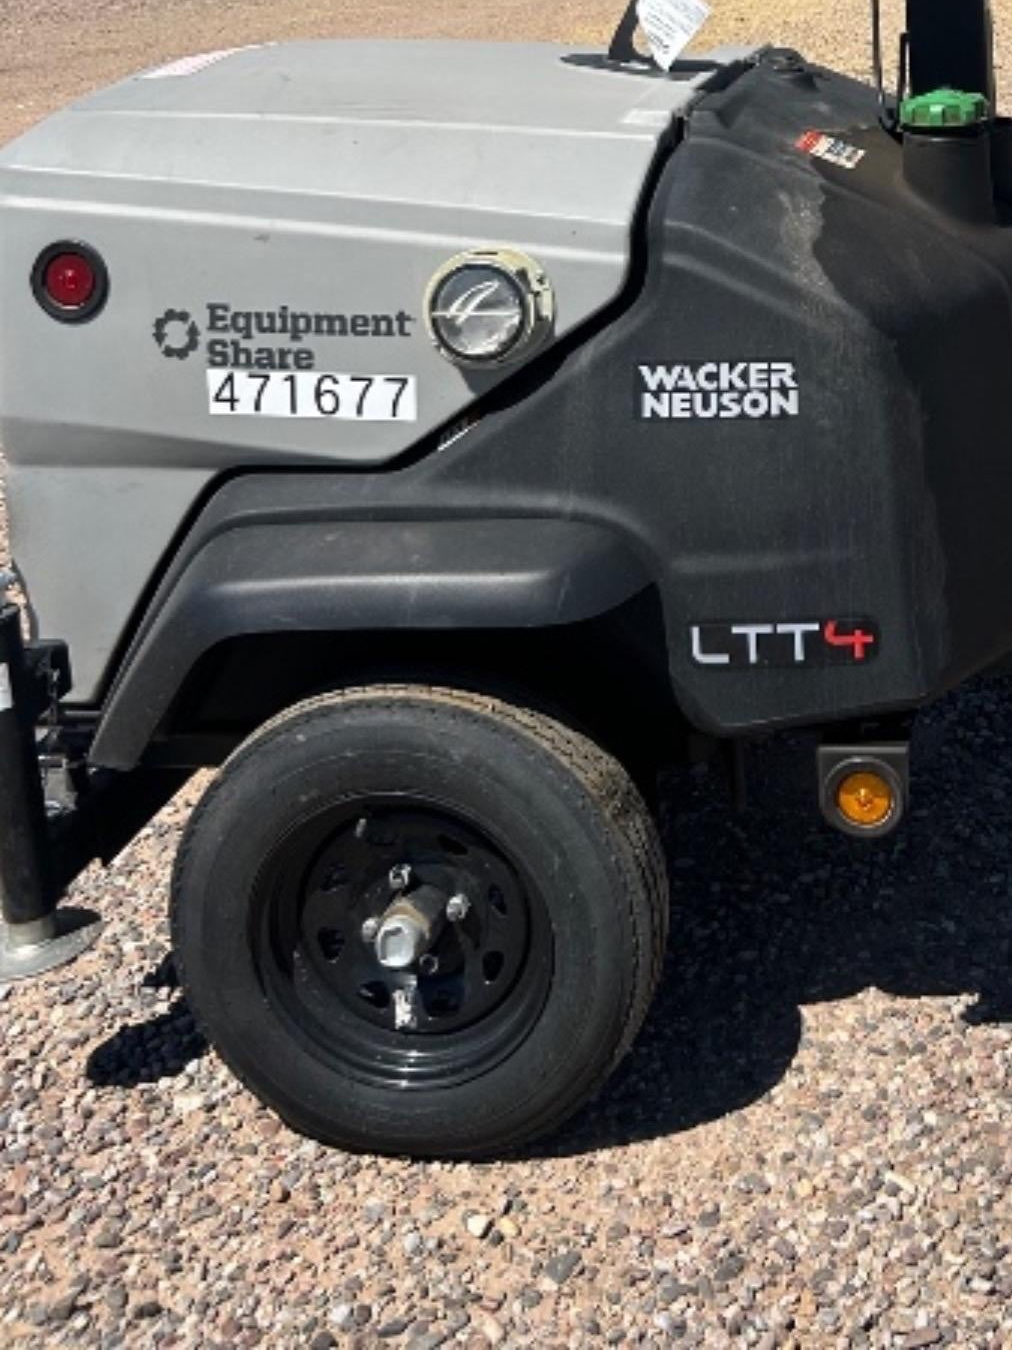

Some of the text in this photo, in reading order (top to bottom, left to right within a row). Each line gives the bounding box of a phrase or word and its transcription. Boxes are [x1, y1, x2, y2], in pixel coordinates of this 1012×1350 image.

[206, 302, 413, 342] Equipment
[206, 338, 315, 369] Share
[638, 361, 799, 391] WACKER
[212, 371, 409, 417] 471677
[642, 389, 799, 419] NEUSON
[691, 620, 875, 664] LTT4
